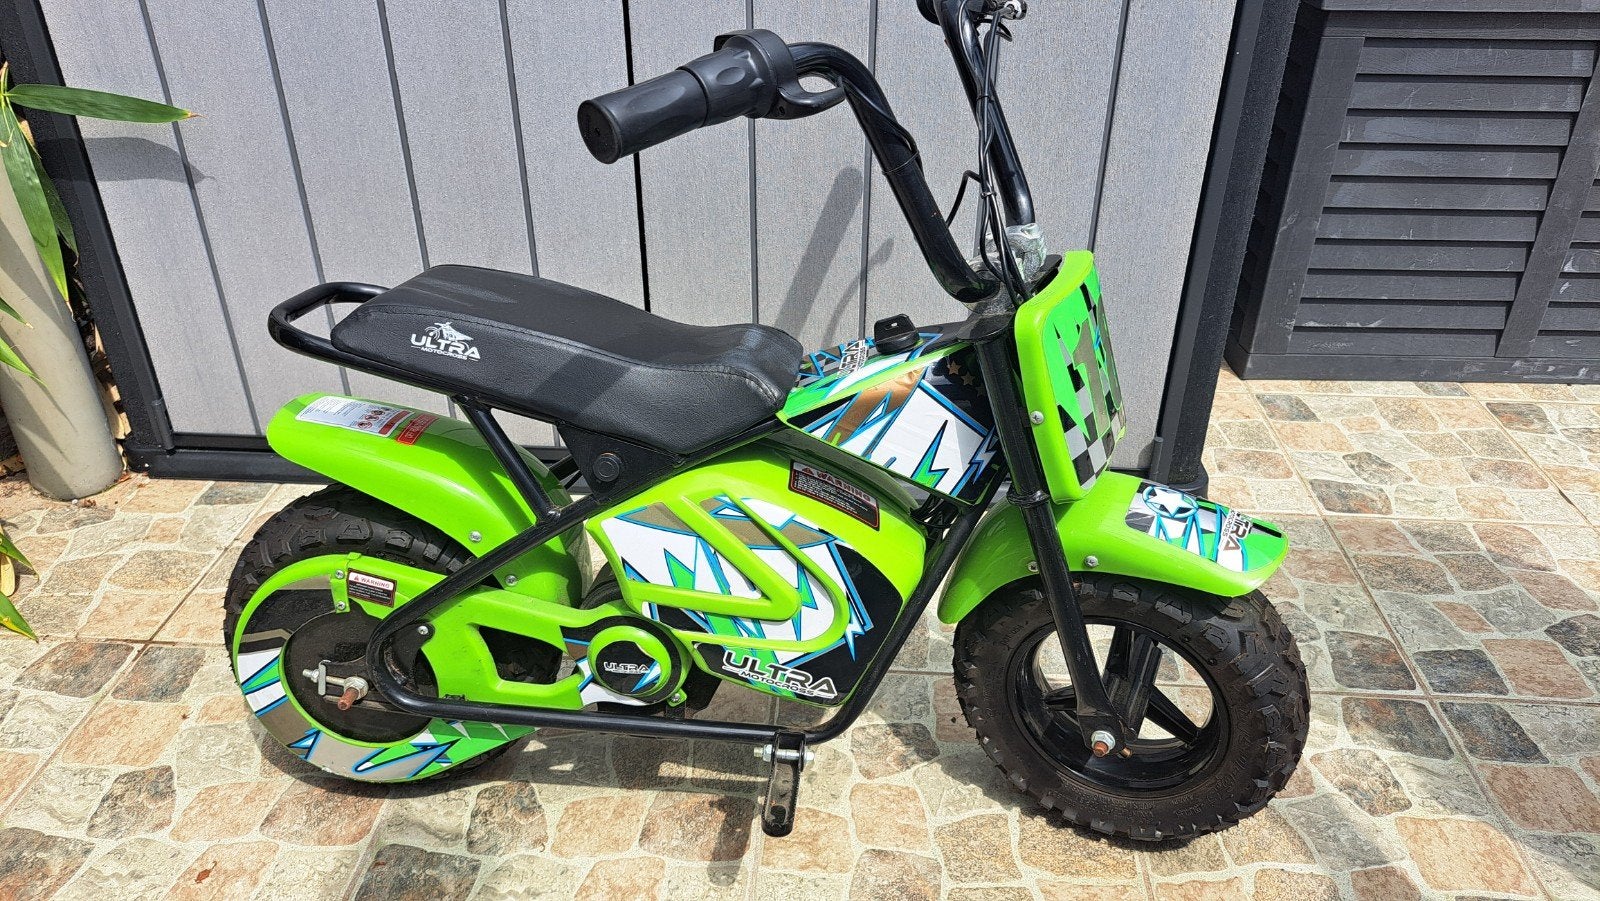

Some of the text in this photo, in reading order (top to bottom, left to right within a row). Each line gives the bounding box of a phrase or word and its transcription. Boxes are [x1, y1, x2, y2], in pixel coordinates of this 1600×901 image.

[410, 333, 481, 360] ULTRA
[420, 346, 468, 361] MOTOCROSS
[817, 470, 871, 502] WARNING
[361, 576, 390, 589] WARNING
[604, 661, 651, 674] ULTRA
[723, 651, 837, 695] ULTRA
[741, 671, 815, 697] MOTOCROSS
